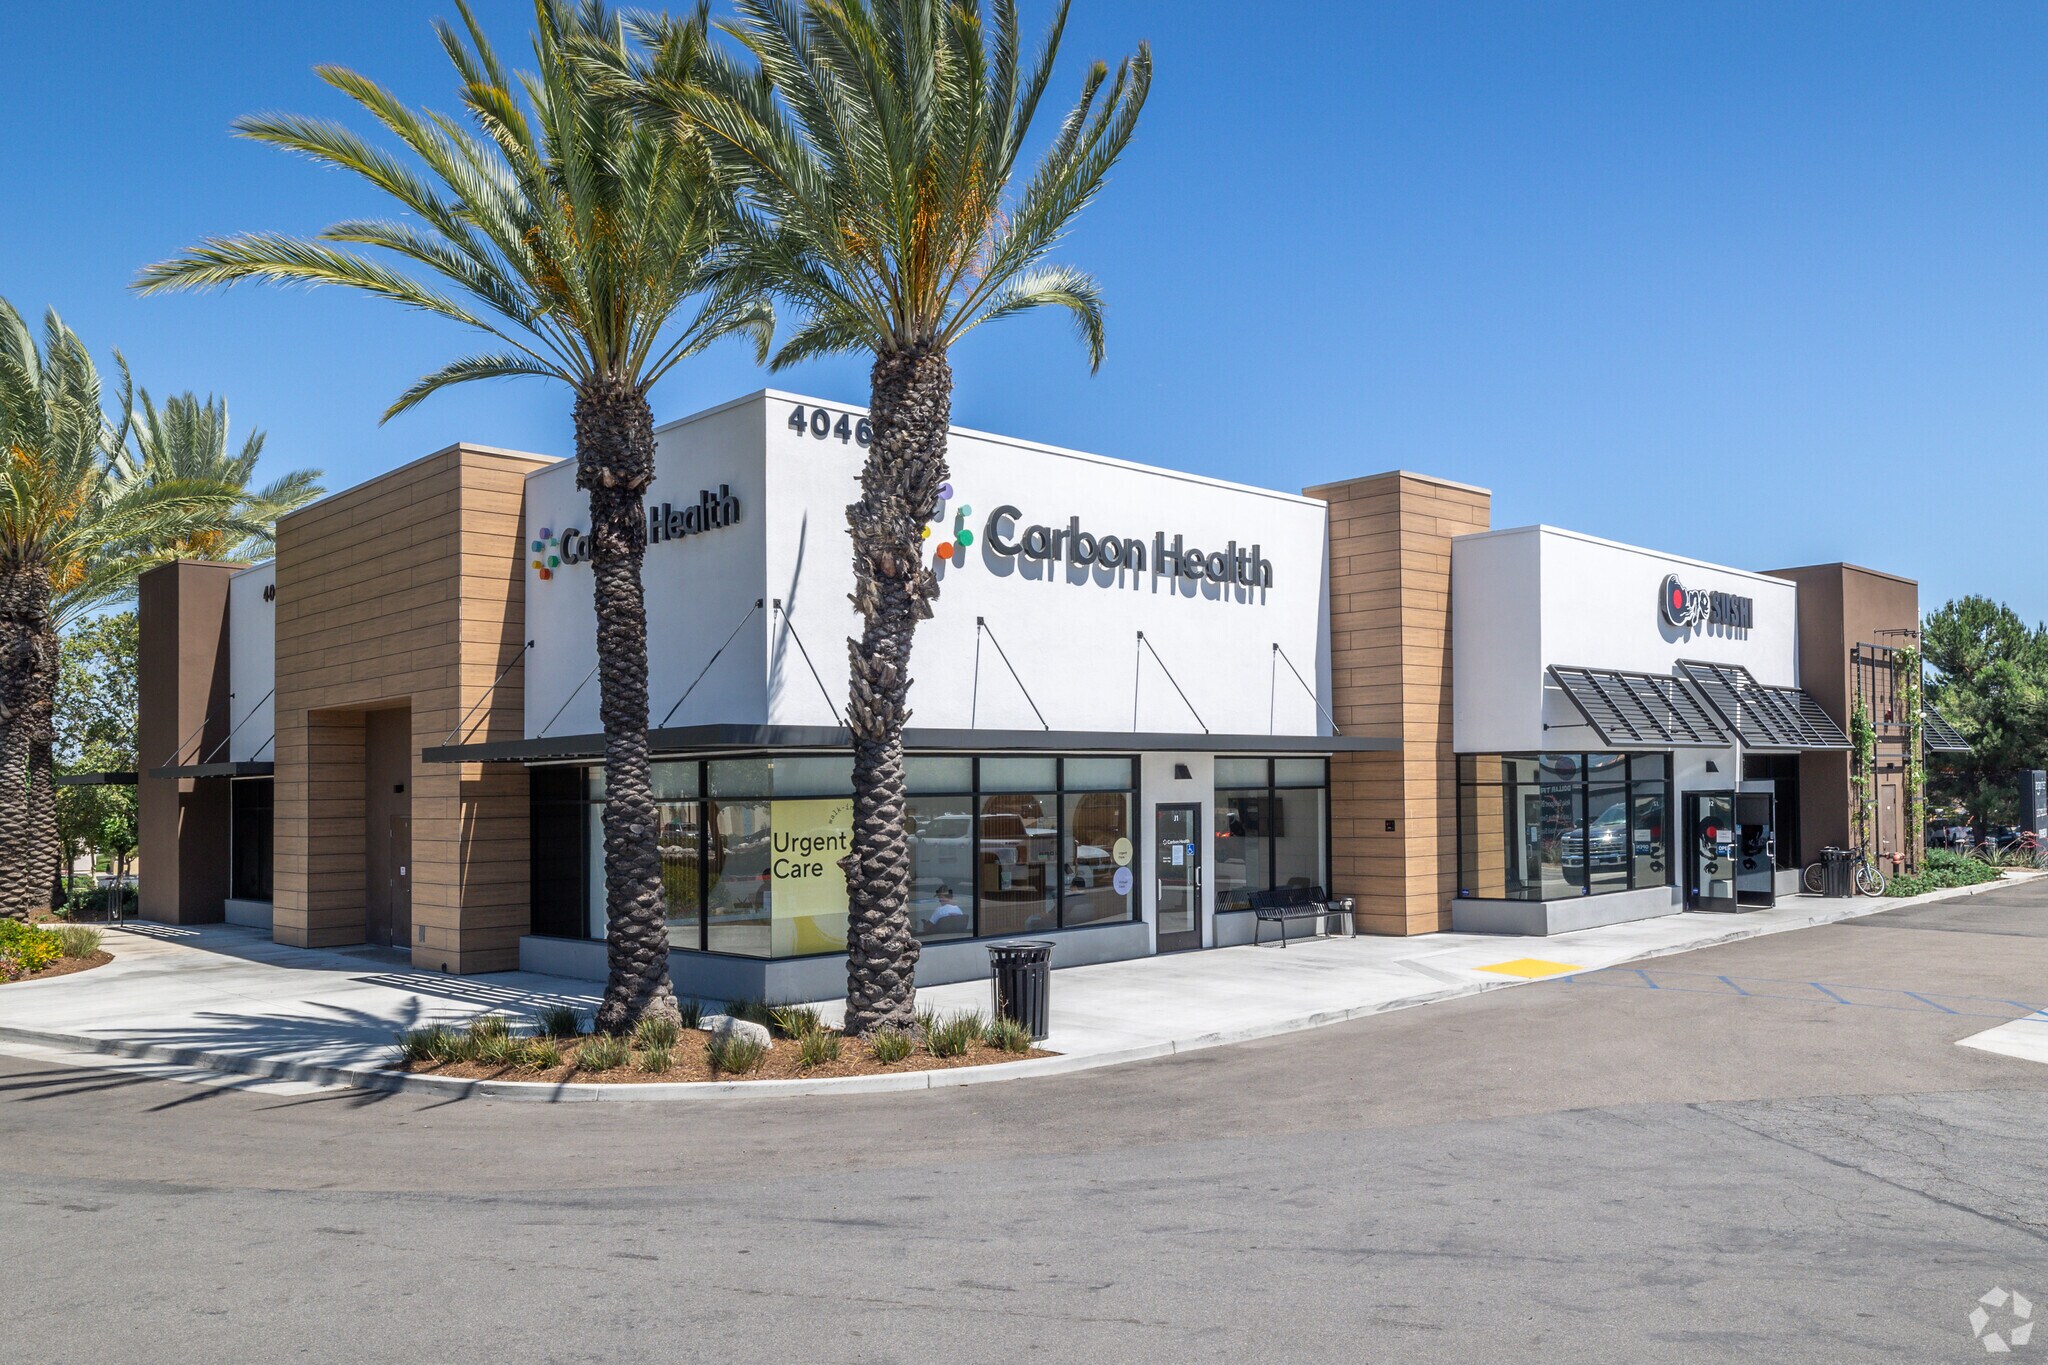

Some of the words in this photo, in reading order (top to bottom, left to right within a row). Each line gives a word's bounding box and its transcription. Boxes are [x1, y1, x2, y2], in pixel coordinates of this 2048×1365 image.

[788, 405, 873, 444] 4046
[650, 484, 740, 544] Health
[987, 505, 1147, 572] Carbon
[1155, 531, 1273, 588] Health
[1709, 590, 1753, 629] SUSHI
[774, 832, 847, 857] Urgent
[773, 858, 824, 879] Care
